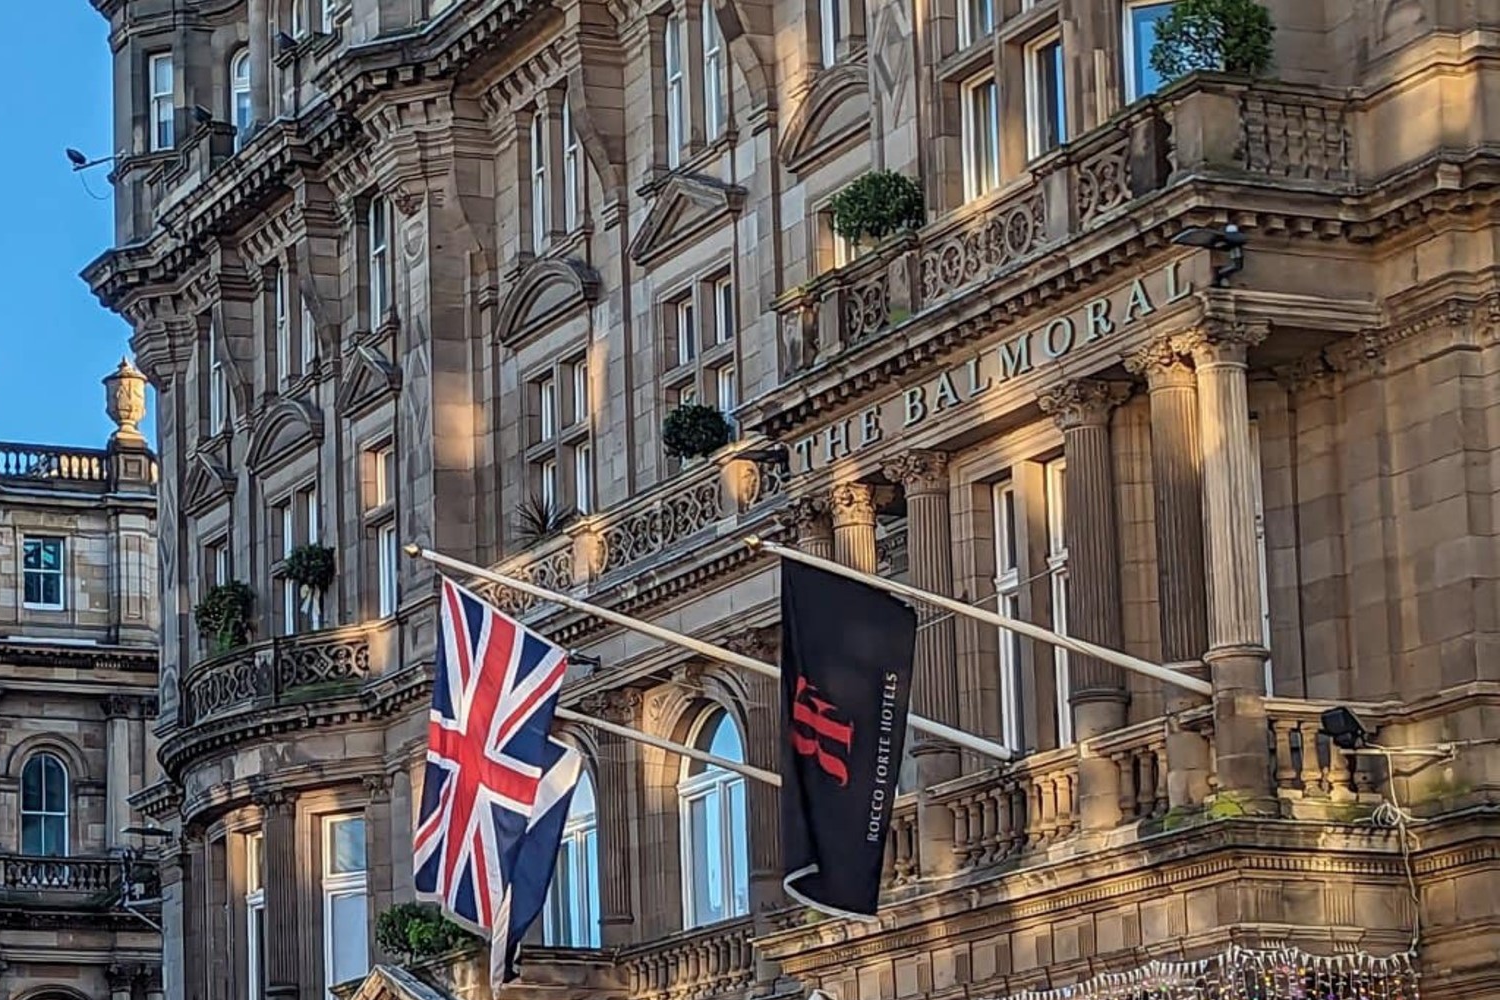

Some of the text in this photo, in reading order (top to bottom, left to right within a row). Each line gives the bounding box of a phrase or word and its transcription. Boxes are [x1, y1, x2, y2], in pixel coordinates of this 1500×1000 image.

[795, 262, 1192, 473] THE BALMORAL
[867, 671, 898, 842] ROCCO FORTE HOTELS
